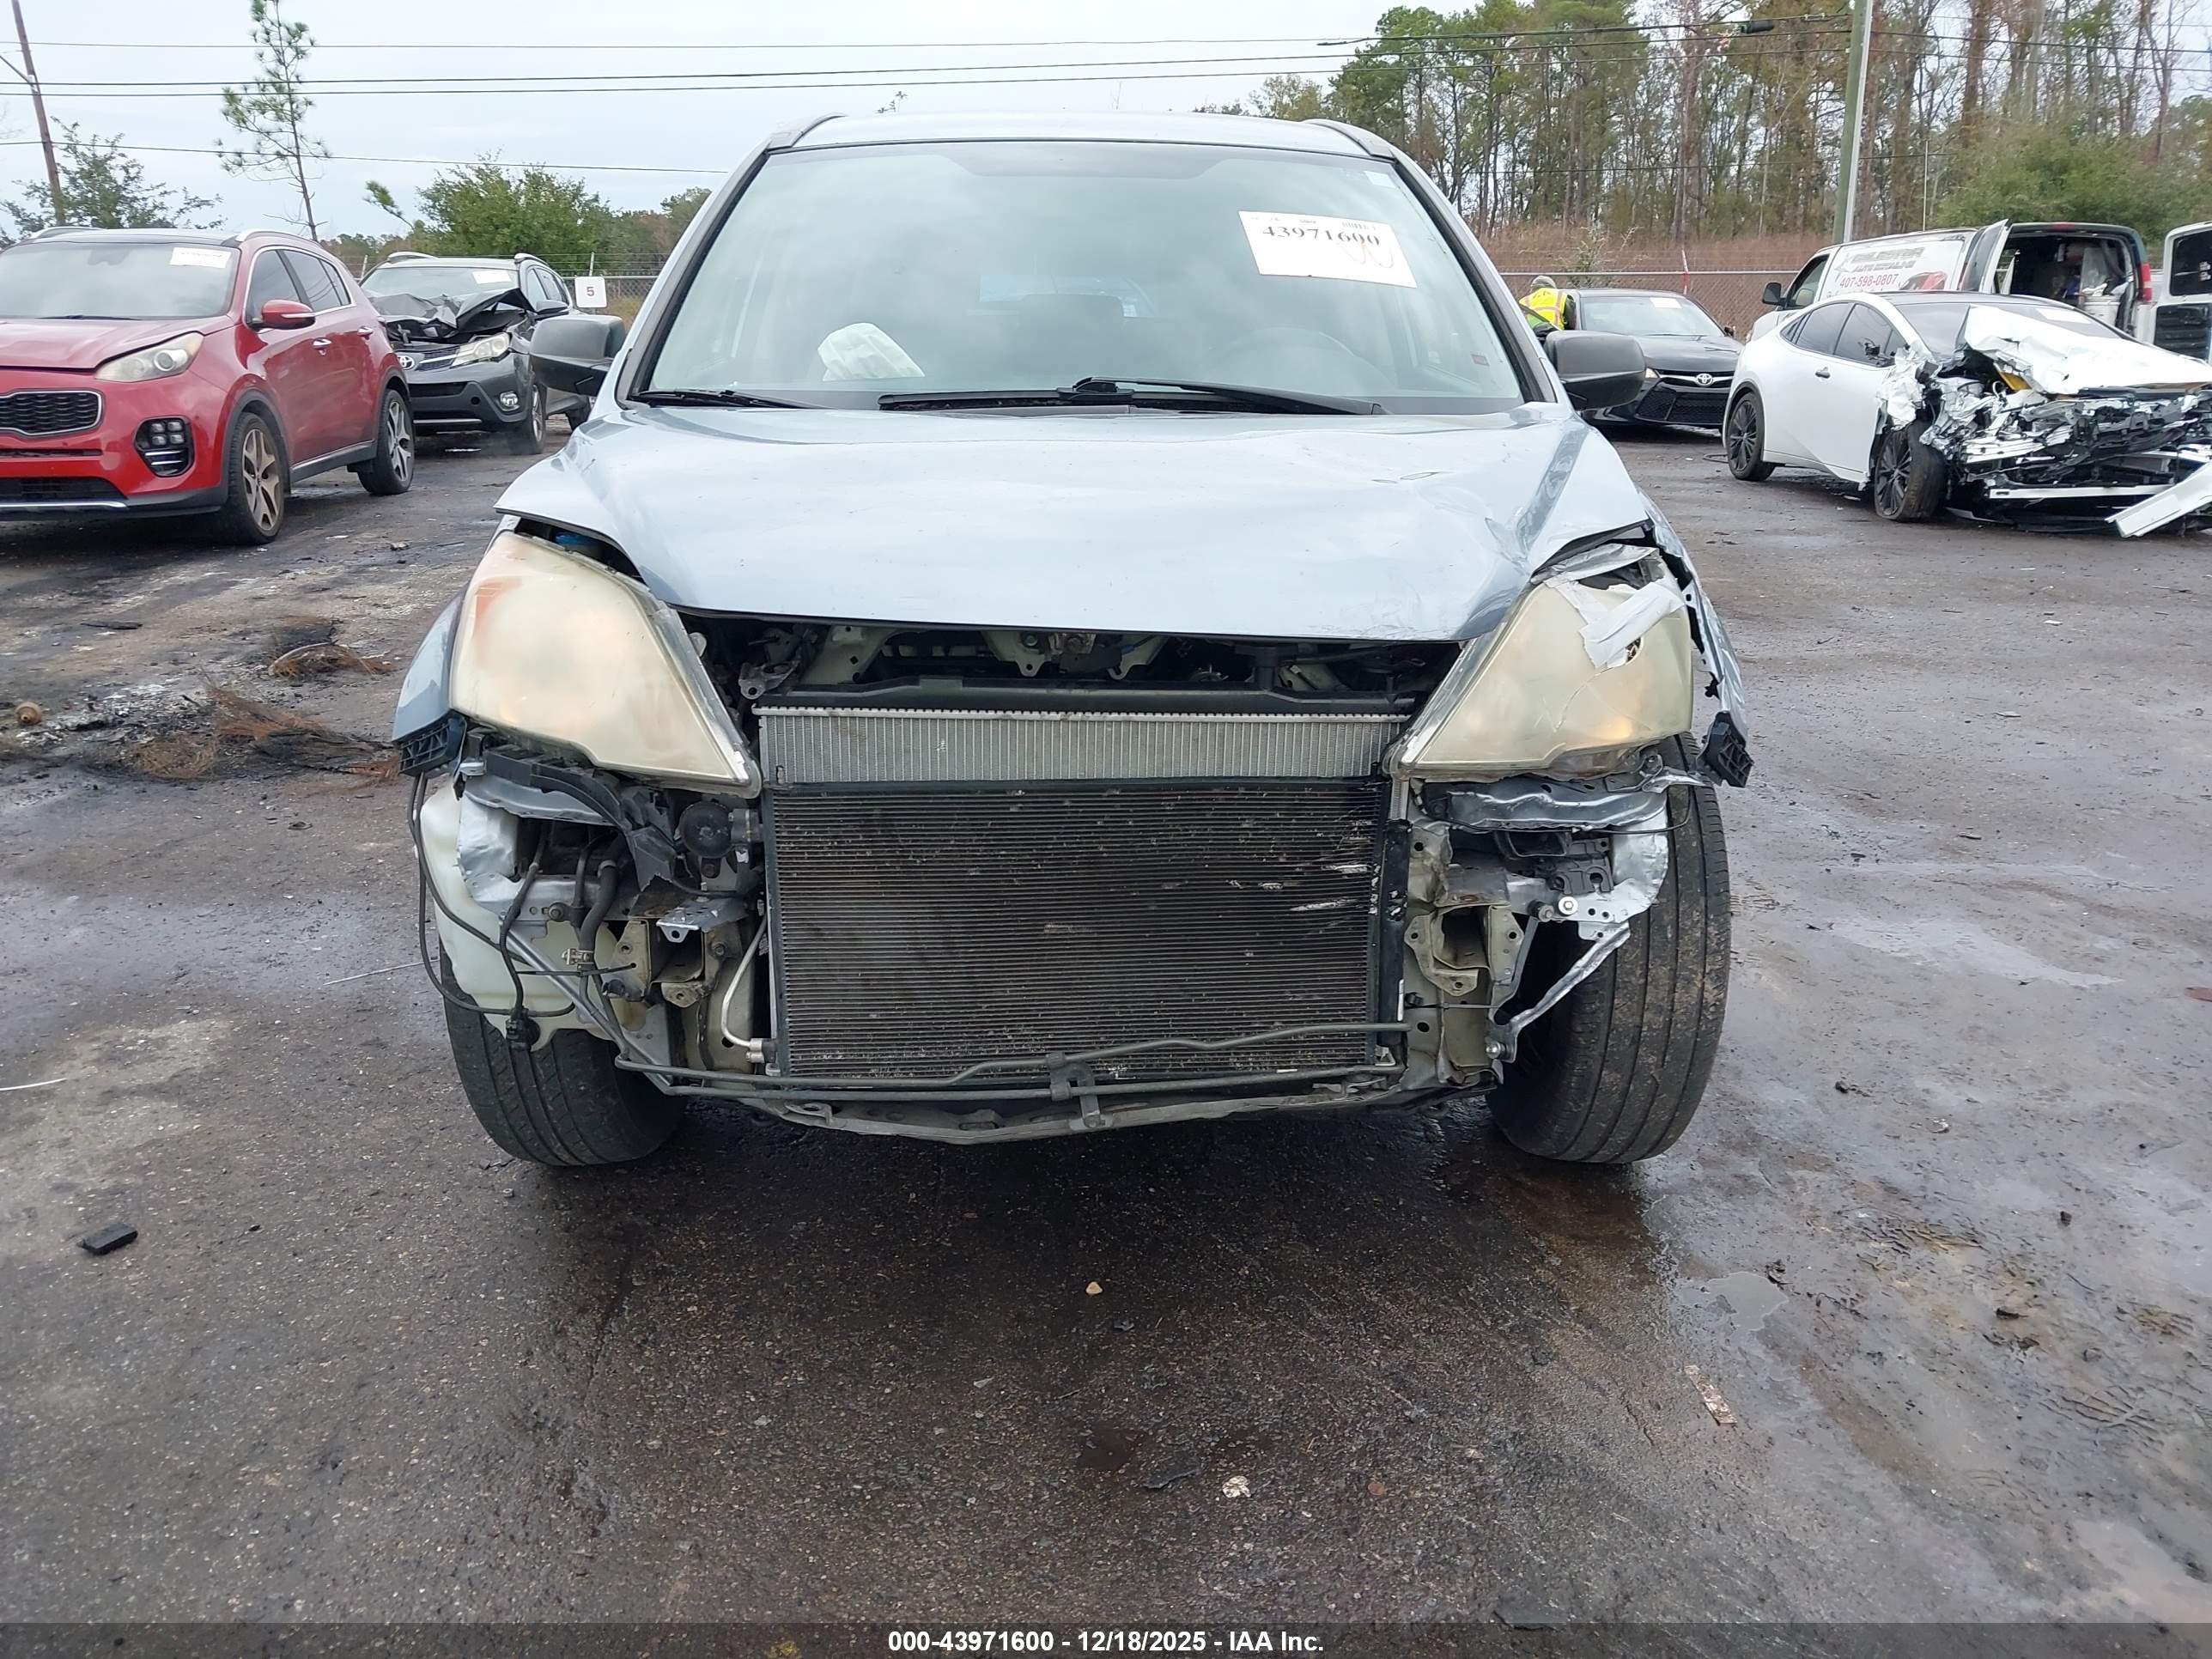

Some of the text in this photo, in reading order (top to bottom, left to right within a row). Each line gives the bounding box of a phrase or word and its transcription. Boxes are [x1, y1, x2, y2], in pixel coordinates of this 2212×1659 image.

[1261, 225, 1381, 246] 43971600
[1839, 273, 1899, 289] 407-598-0807
[586, 286, 595, 297] 5
